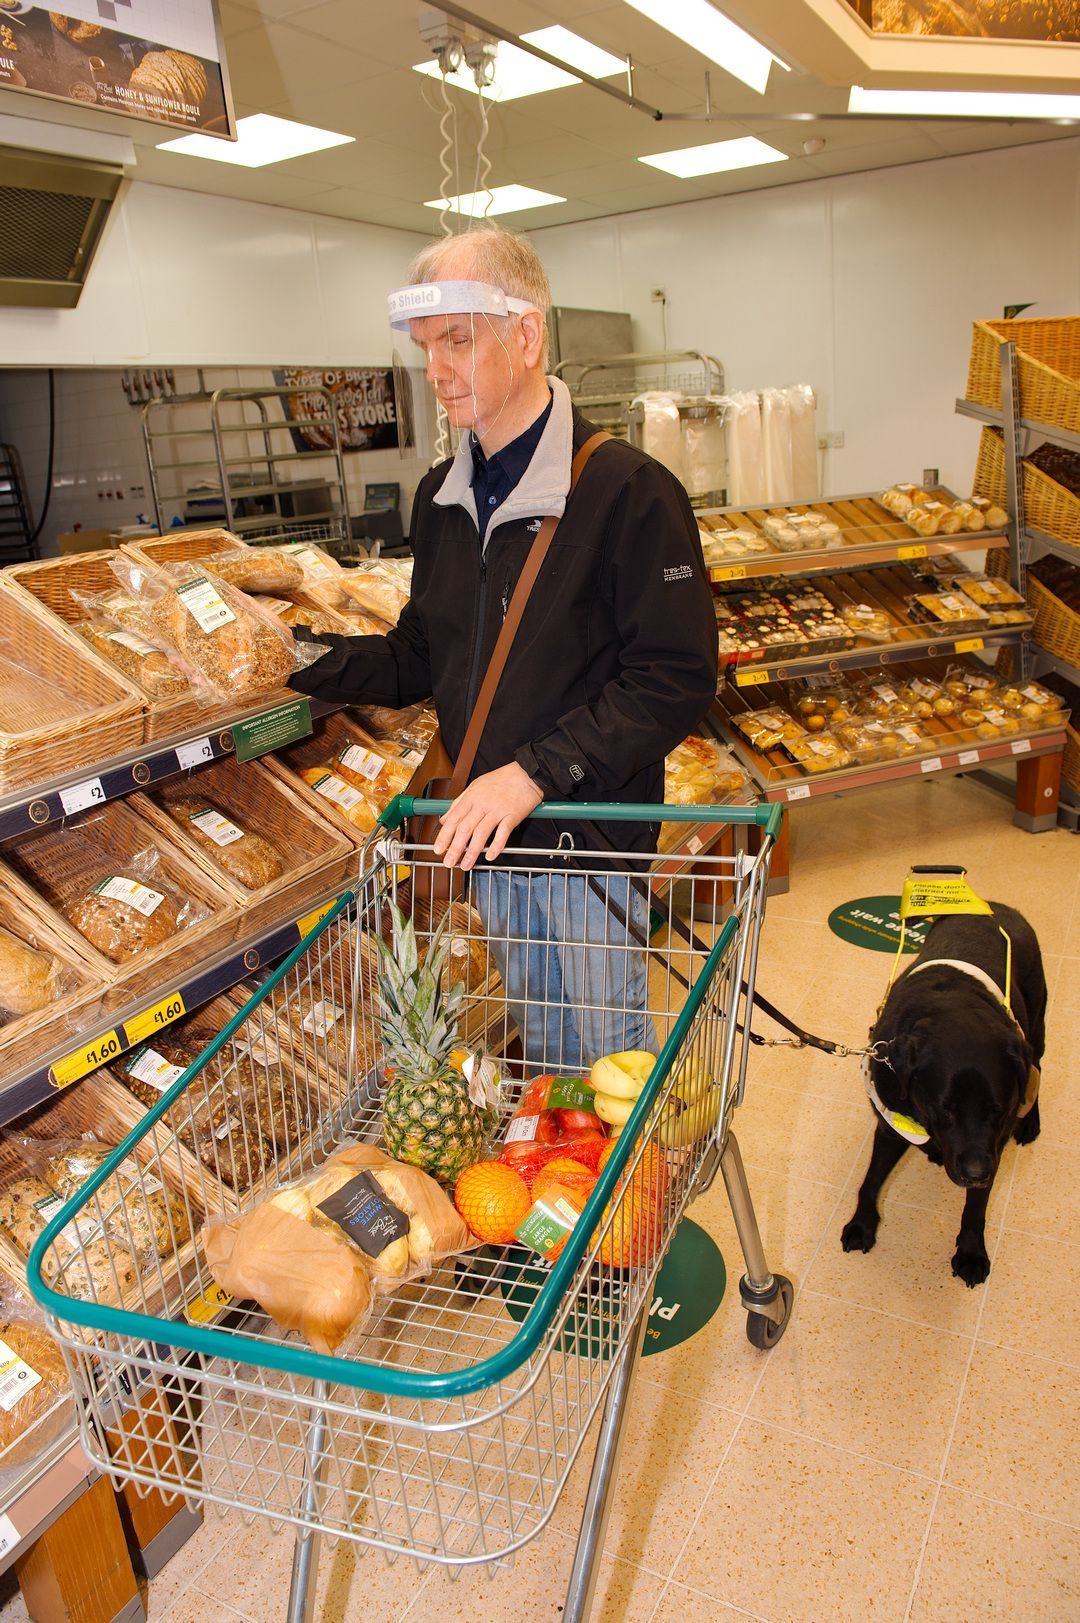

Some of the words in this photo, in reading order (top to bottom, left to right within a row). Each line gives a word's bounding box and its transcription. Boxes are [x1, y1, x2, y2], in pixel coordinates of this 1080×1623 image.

[0, 57, 15, 70] ULE
[114, 86, 137, 100] HONEY
[138, 92, 144, 101] &
[145, 93, 181, 111] SUNFLOWER
[181, 103, 200, 116] BOULE
[398, 290, 434, 308] Shield
[324, 369, 342, 385] OF
[350, 401, 397, 428] STORE
[201, 745, 212, 758] £2
[91, 786, 104, 800] £2
[850, 909, 884, 925] wait
[155, 1001, 182, 1023] £1.60
[86, 1039, 117, 1064] £1.60
[349, 1198, 380, 1226] OTATOES
[359, 1203, 384, 1226] WHITE
[532, 1225, 546, 1240] LARGE
[534, 1226, 553, 1246] ORANGES
[216, 1289, 232, 1302] £1.
